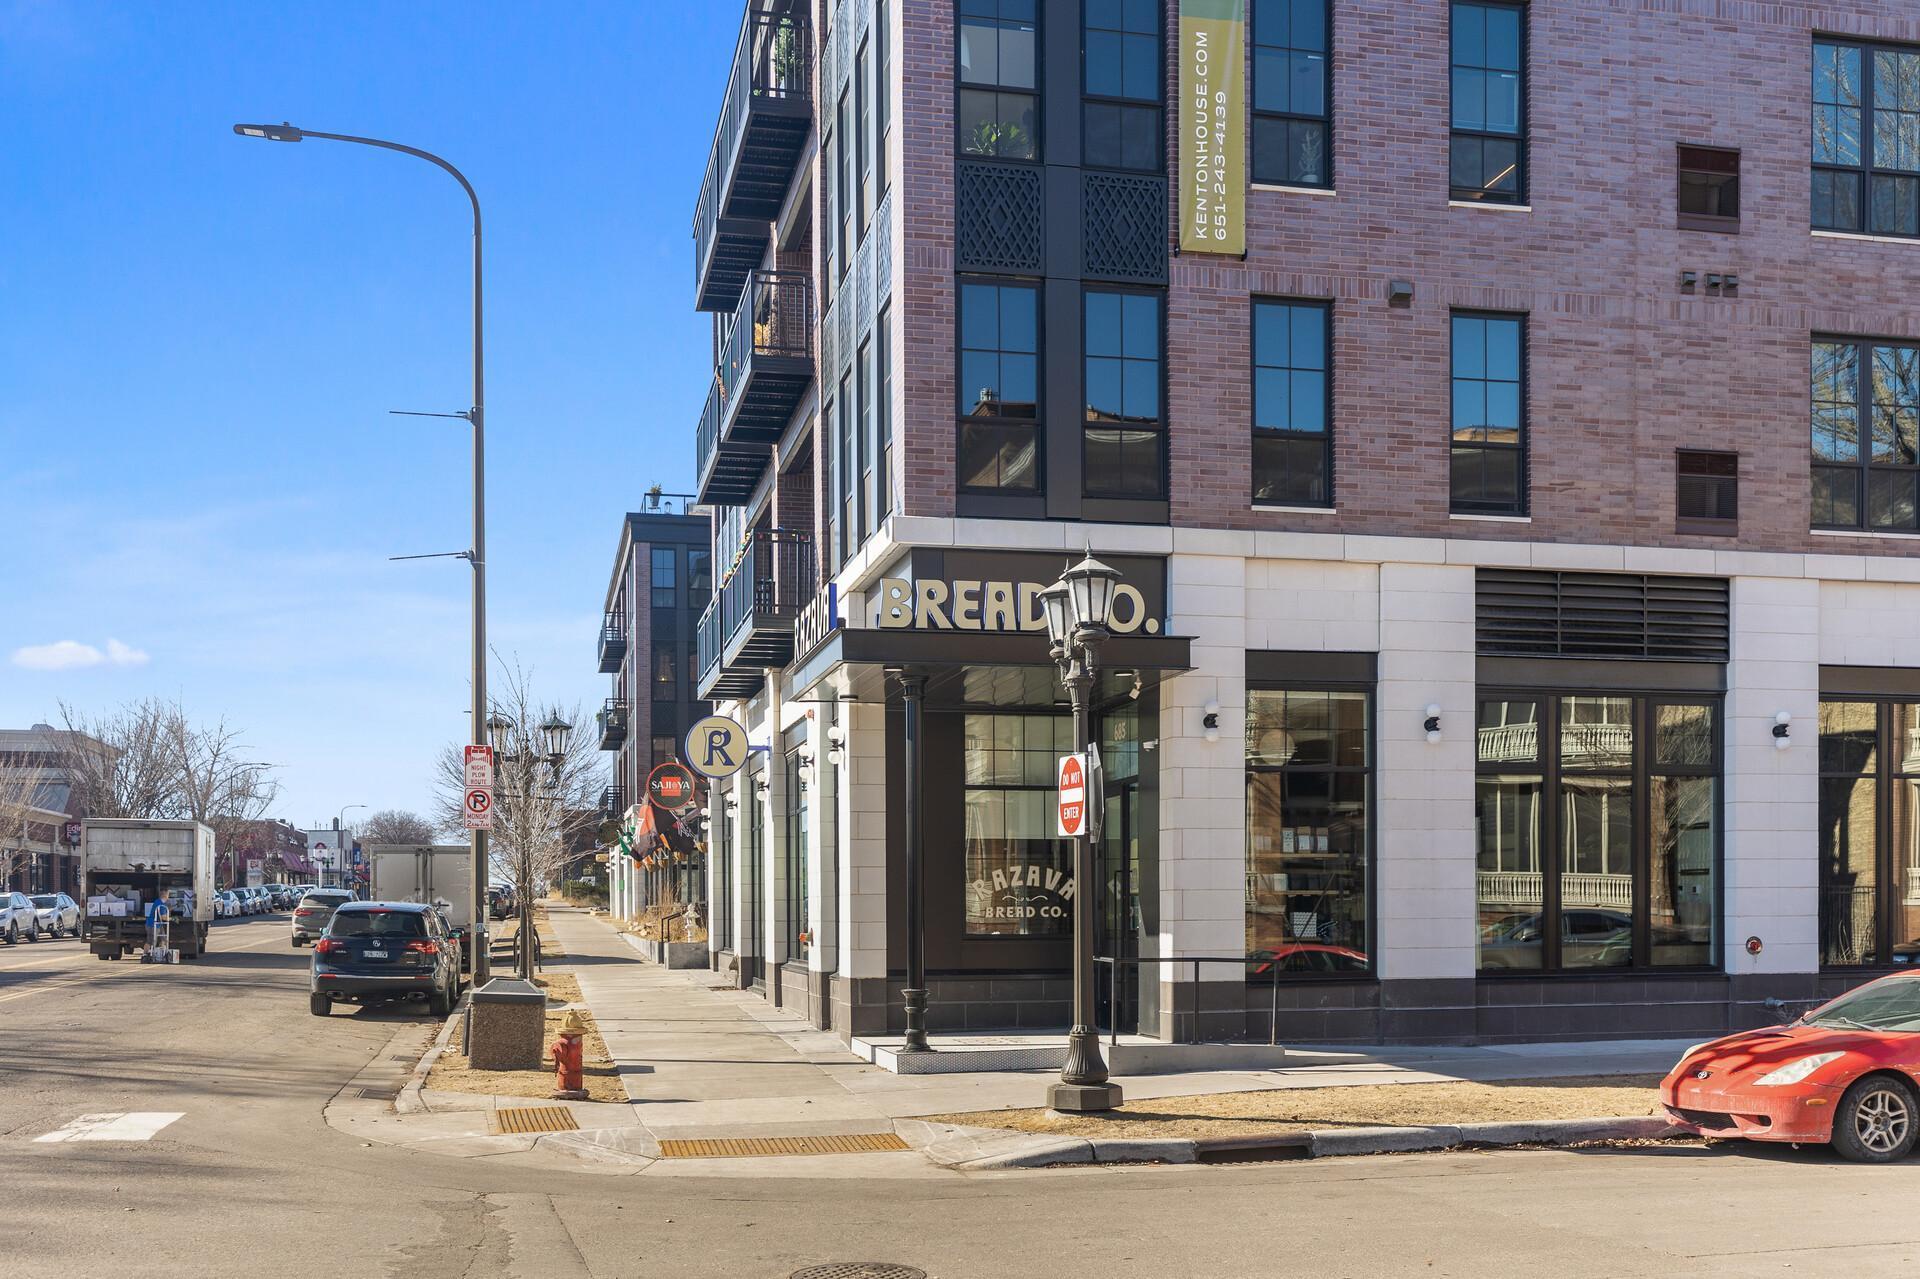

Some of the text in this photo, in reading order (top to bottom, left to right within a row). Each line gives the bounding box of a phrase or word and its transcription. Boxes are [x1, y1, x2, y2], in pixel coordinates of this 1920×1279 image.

[1195, 31, 1208, 239] KENTONHOUSE.COM
[1215, 91, 1227, 241] 651-243-4139
[793, 582, 830, 665] RAZAVA
[878, 577, 1050, 632] BREAD
[702, 725, 736, 767] R
[1062, 771, 1081, 786] DO NOT
[1063, 806, 1080, 820] ENTER
[971, 865, 1075, 901] RAZAVA
[985, 905, 1068, 918] BREAD CO.
